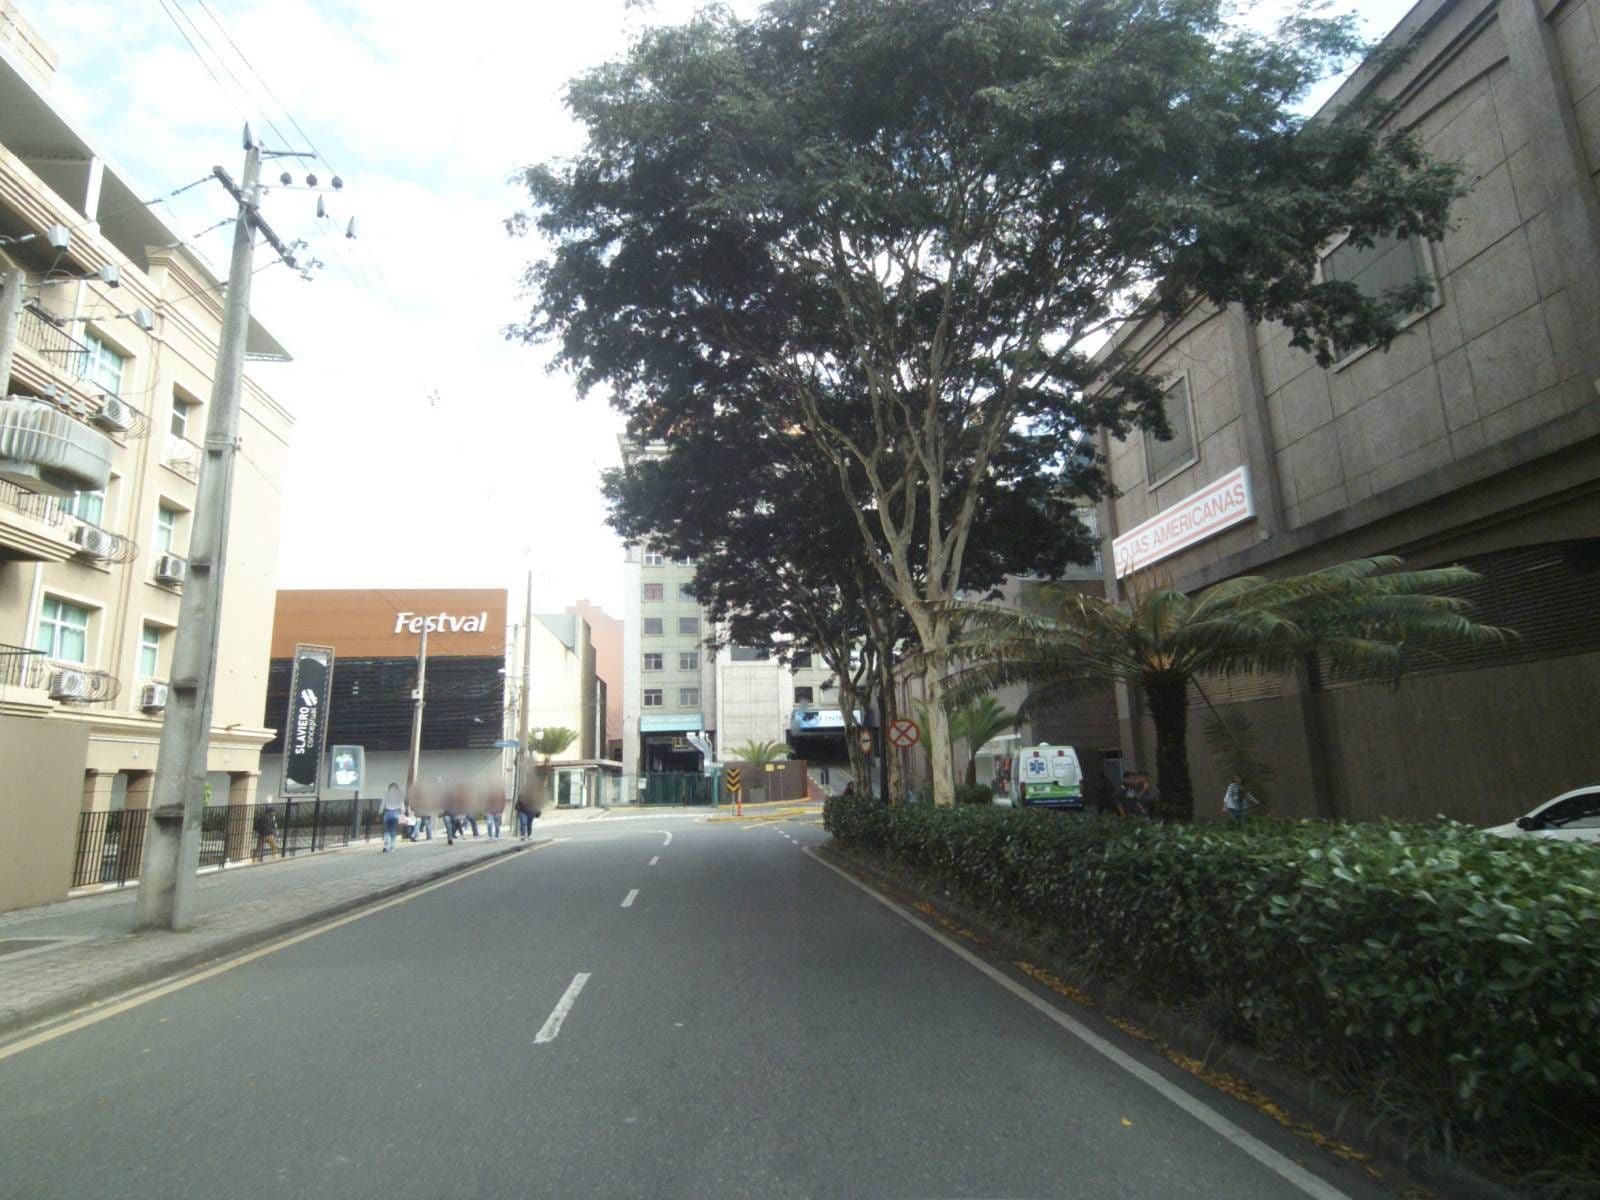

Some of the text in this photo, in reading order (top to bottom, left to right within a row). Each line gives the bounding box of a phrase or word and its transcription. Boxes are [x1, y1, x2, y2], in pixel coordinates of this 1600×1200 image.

[1115, 483, 1246, 567] LOJAS AMERICANAS
[394, 611, 488, 634] Festval
[294, 706, 310, 755] SLAVIERO
